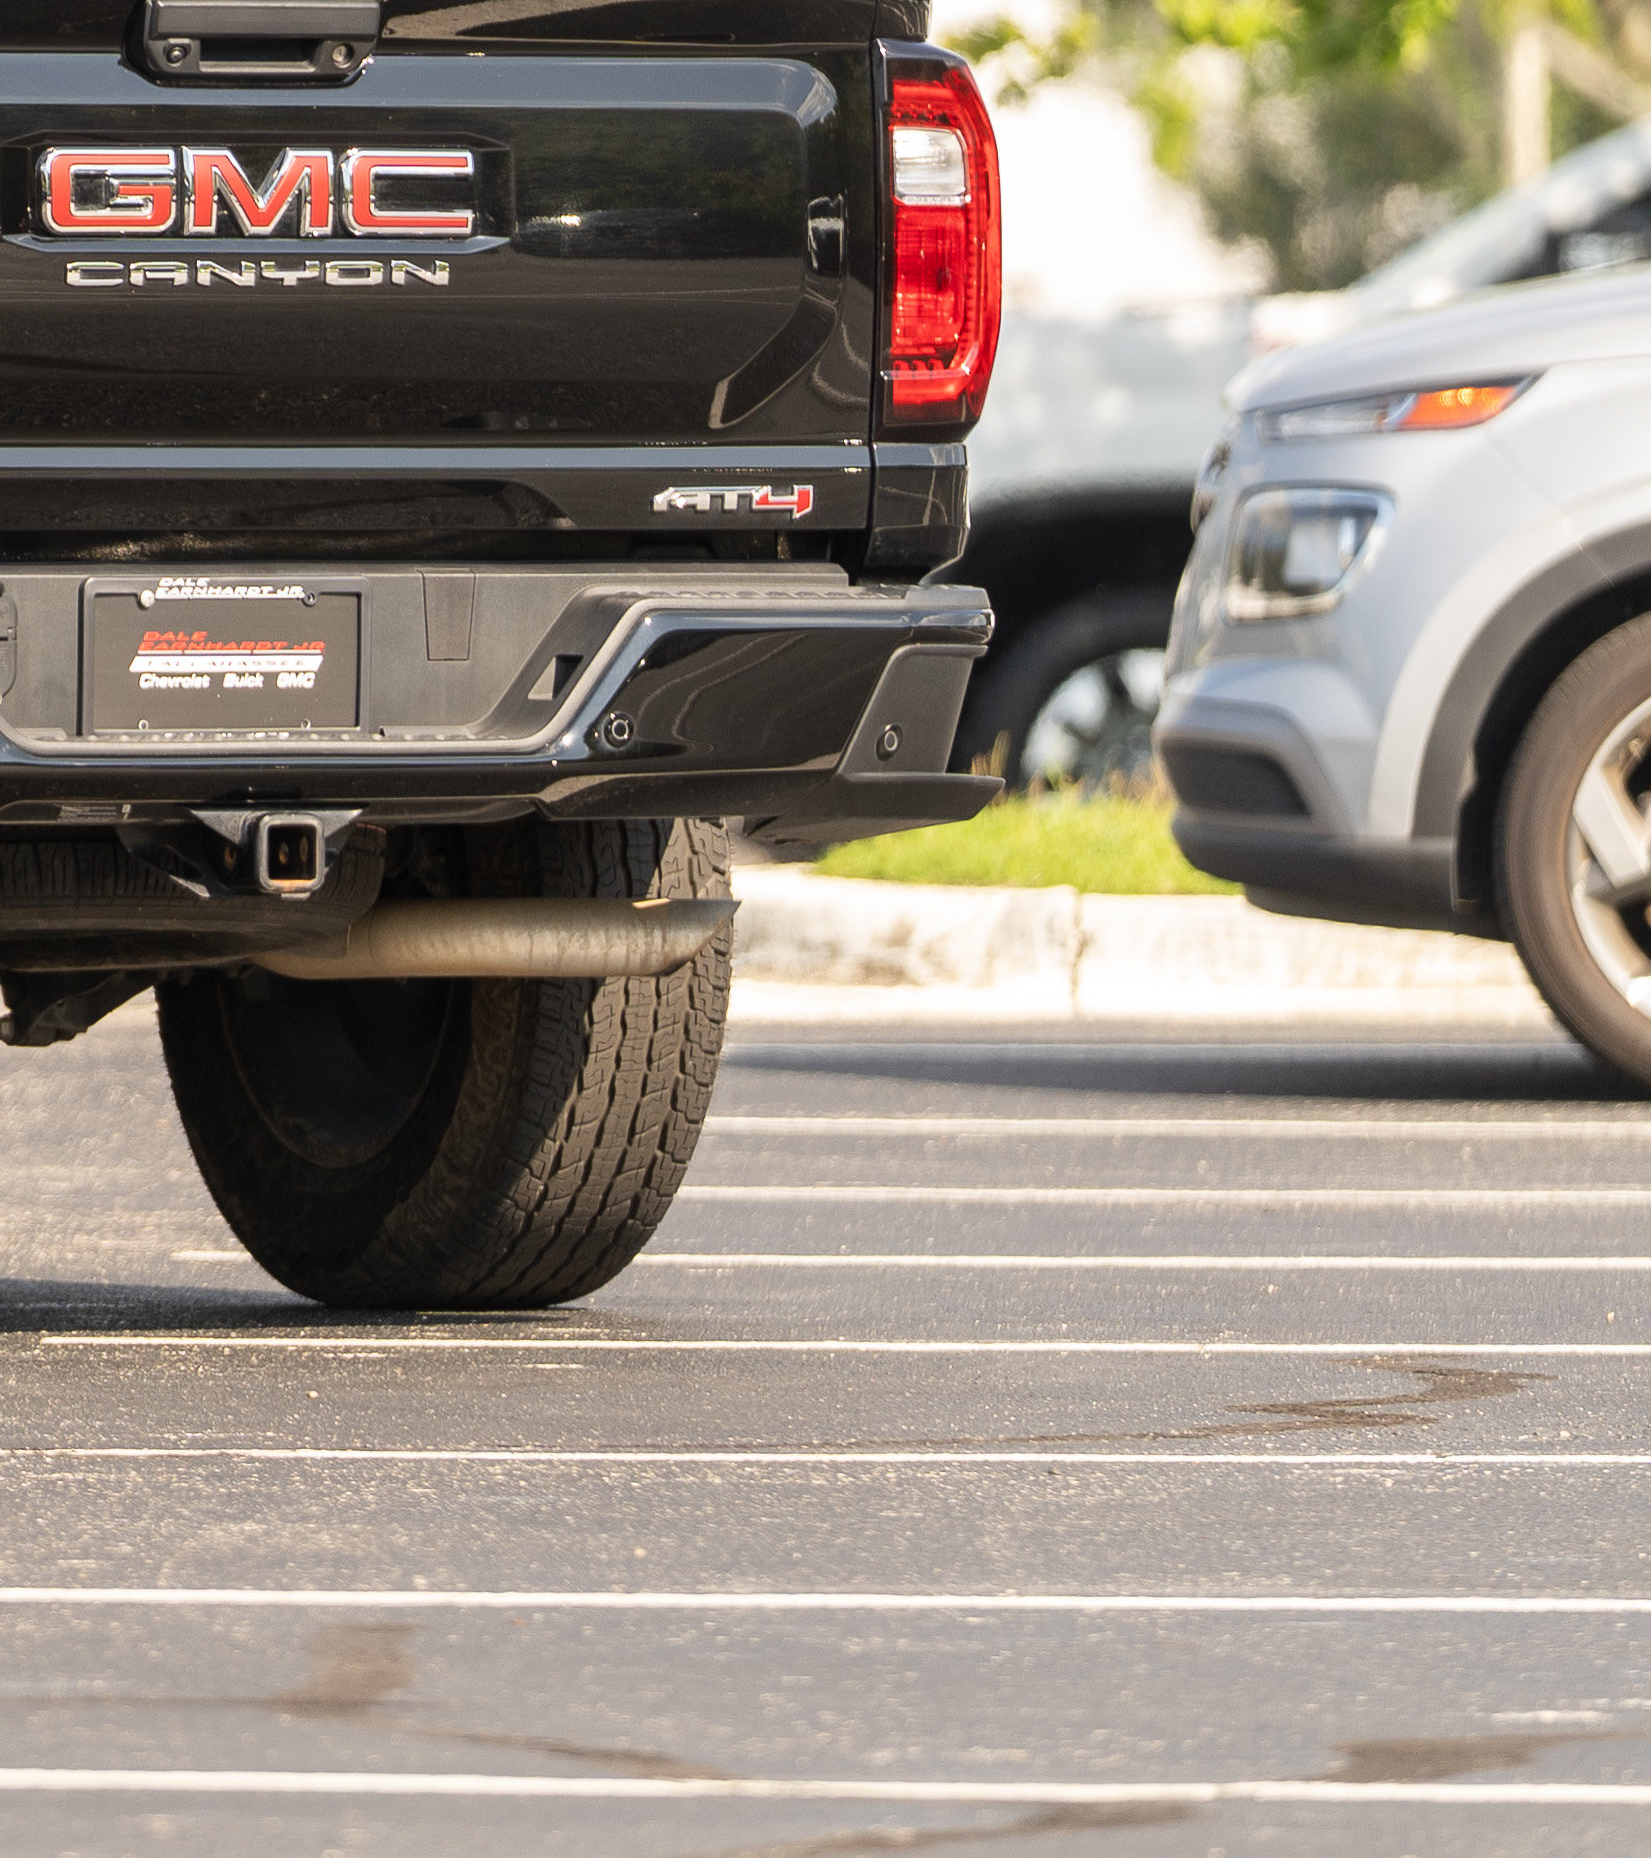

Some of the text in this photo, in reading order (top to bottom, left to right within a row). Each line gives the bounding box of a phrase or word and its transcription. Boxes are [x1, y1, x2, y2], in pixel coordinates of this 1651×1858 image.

[36, 145, 476, 237] GMC
[65, 260, 450, 288] CANYON
[653, 485, 814, 519] AT4
[158, 577, 210, 587] DALE
[155, 586, 274, 599] EARNHARDT
[143, 631, 208, 642] DALE
[138, 641, 288, 651] EARNHARDT
[139, 671, 316, 689] Chevrolet Buick GMC
